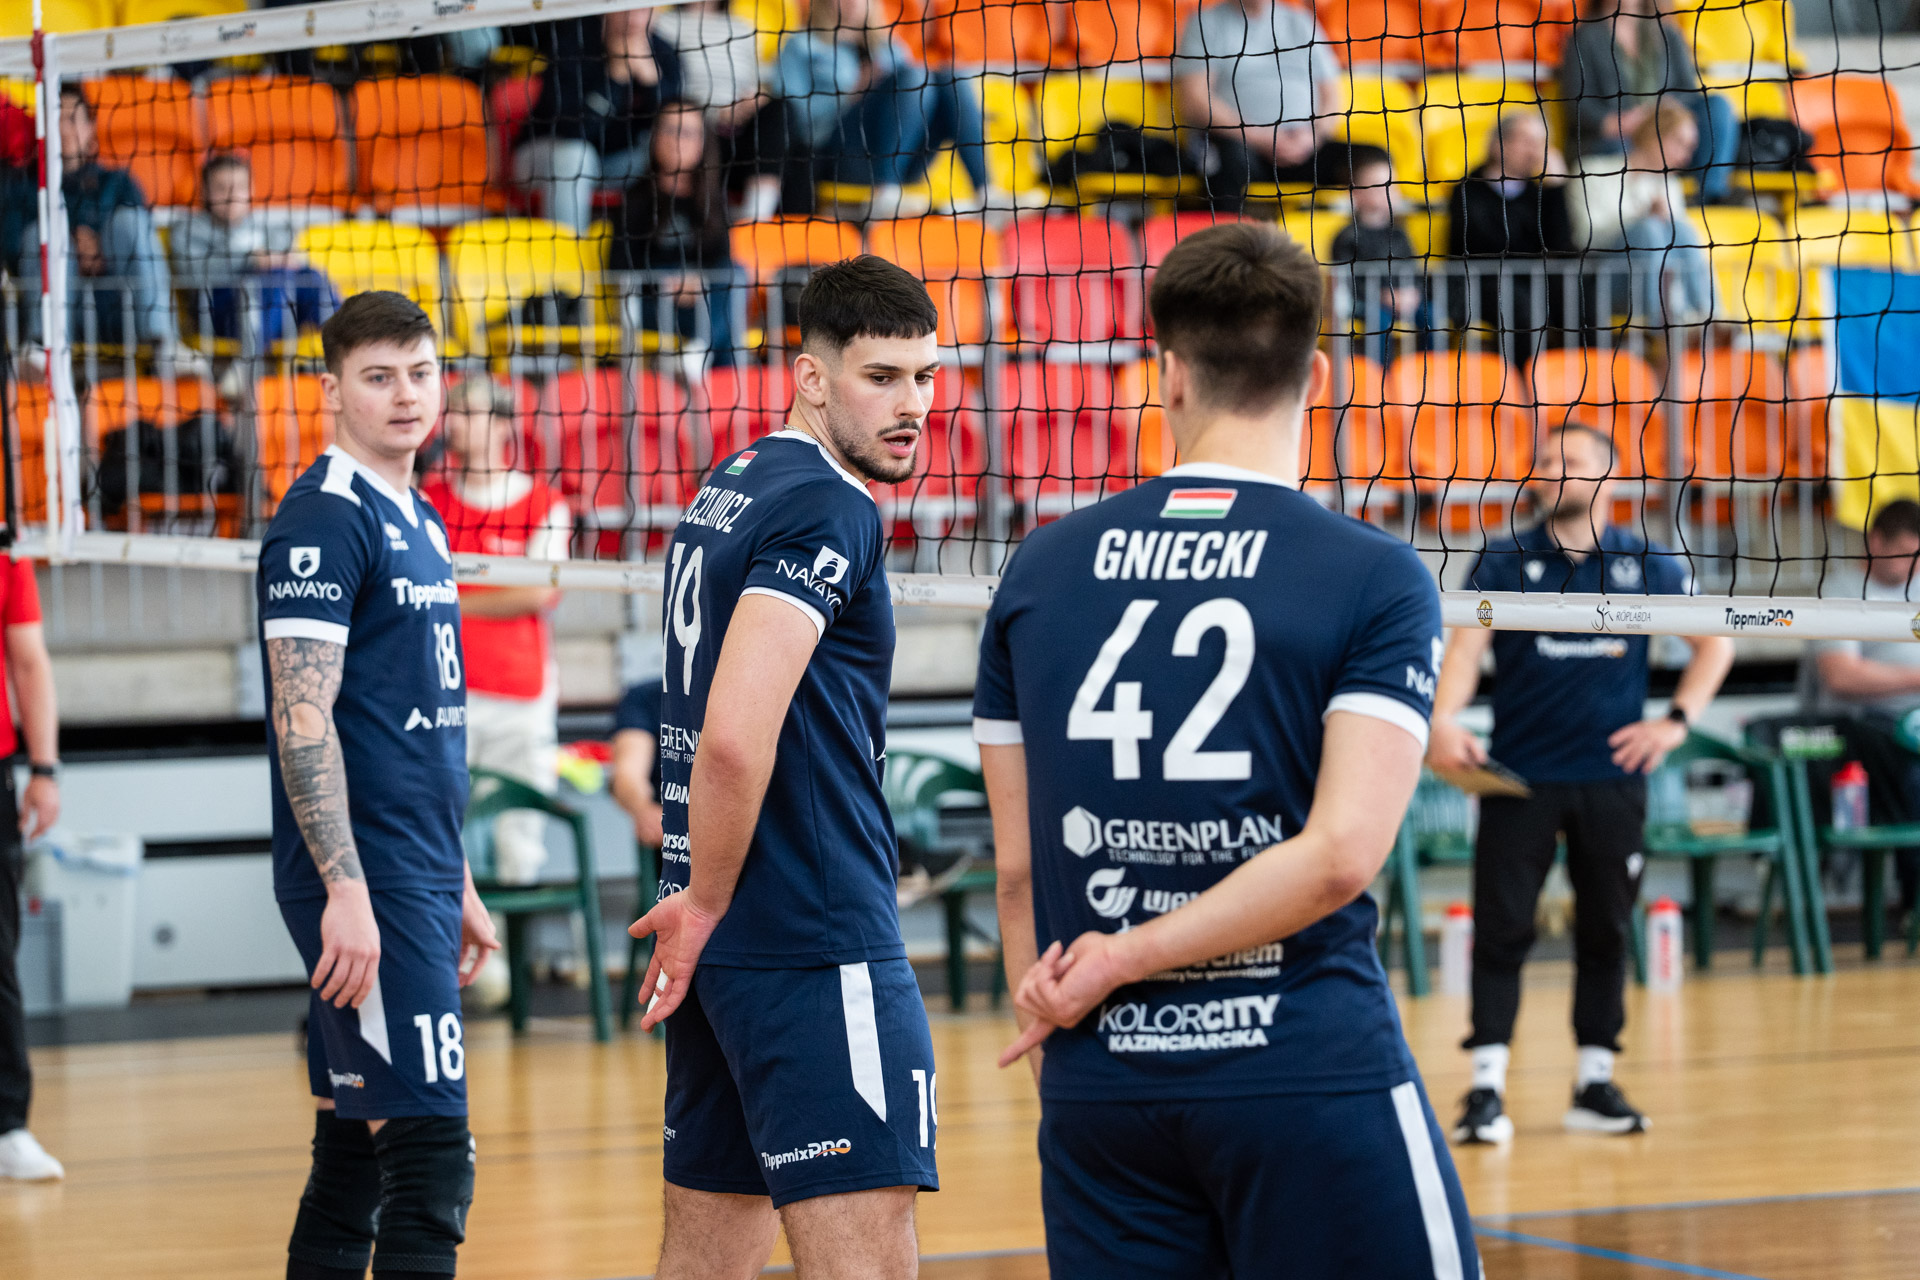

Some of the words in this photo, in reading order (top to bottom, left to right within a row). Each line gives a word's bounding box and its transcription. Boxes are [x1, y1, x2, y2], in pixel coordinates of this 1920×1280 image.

[1093, 528, 1268, 581] GNIECKI
[268, 580, 342, 601] NAVAYO
[663, 542, 704, 696] 19
[1725, 608, 1794, 630] TippmixPRO
[433, 622, 461, 690] 18
[1067, 598, 1255, 781] 42
[1103, 815, 1283, 851] GREENPLAN
[1108, 848, 1177, 866] TECHNOLOGY
[1182, 851, 1205, 866] FOR
[1211, 851, 1235, 864] THE
[1205, 965, 1281, 981] generations
[1097, 994, 1281, 1034] KOLORCITY
[413, 1012, 465, 1083] 18
[1108, 1028, 1269, 1053] KAZINCBARCIKA
[663, 1125, 676, 1139] ORT
[761, 1138, 852, 1170] TippmixPRO
